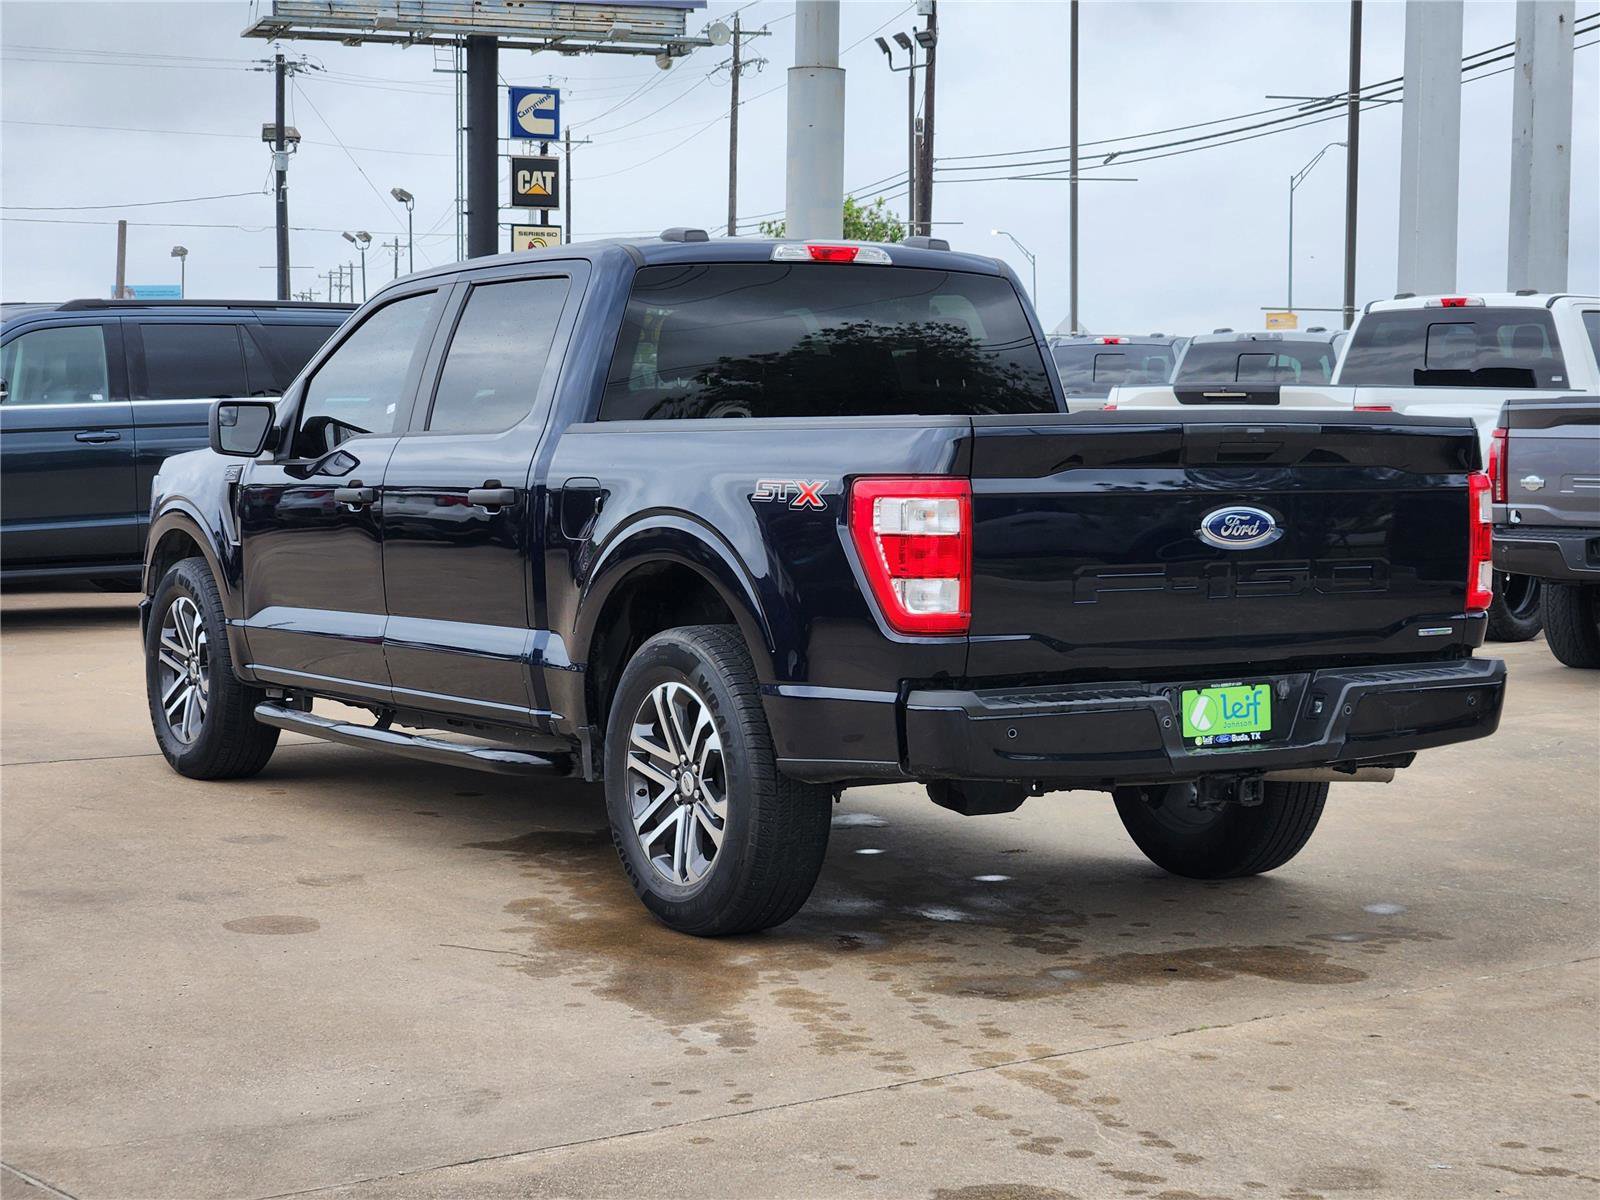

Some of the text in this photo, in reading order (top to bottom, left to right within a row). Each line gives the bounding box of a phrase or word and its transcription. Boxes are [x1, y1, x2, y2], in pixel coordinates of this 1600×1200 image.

[517, 94, 551, 118] Cummins
[517, 170, 556, 195] CAT
[751, 479, 828, 511] STX
[1220, 514, 1260, 536] Ford
[1072, 558, 1390, 604] F-150
[1220, 690, 1262, 725] leif
[1250, 732, 1261, 740] TX
